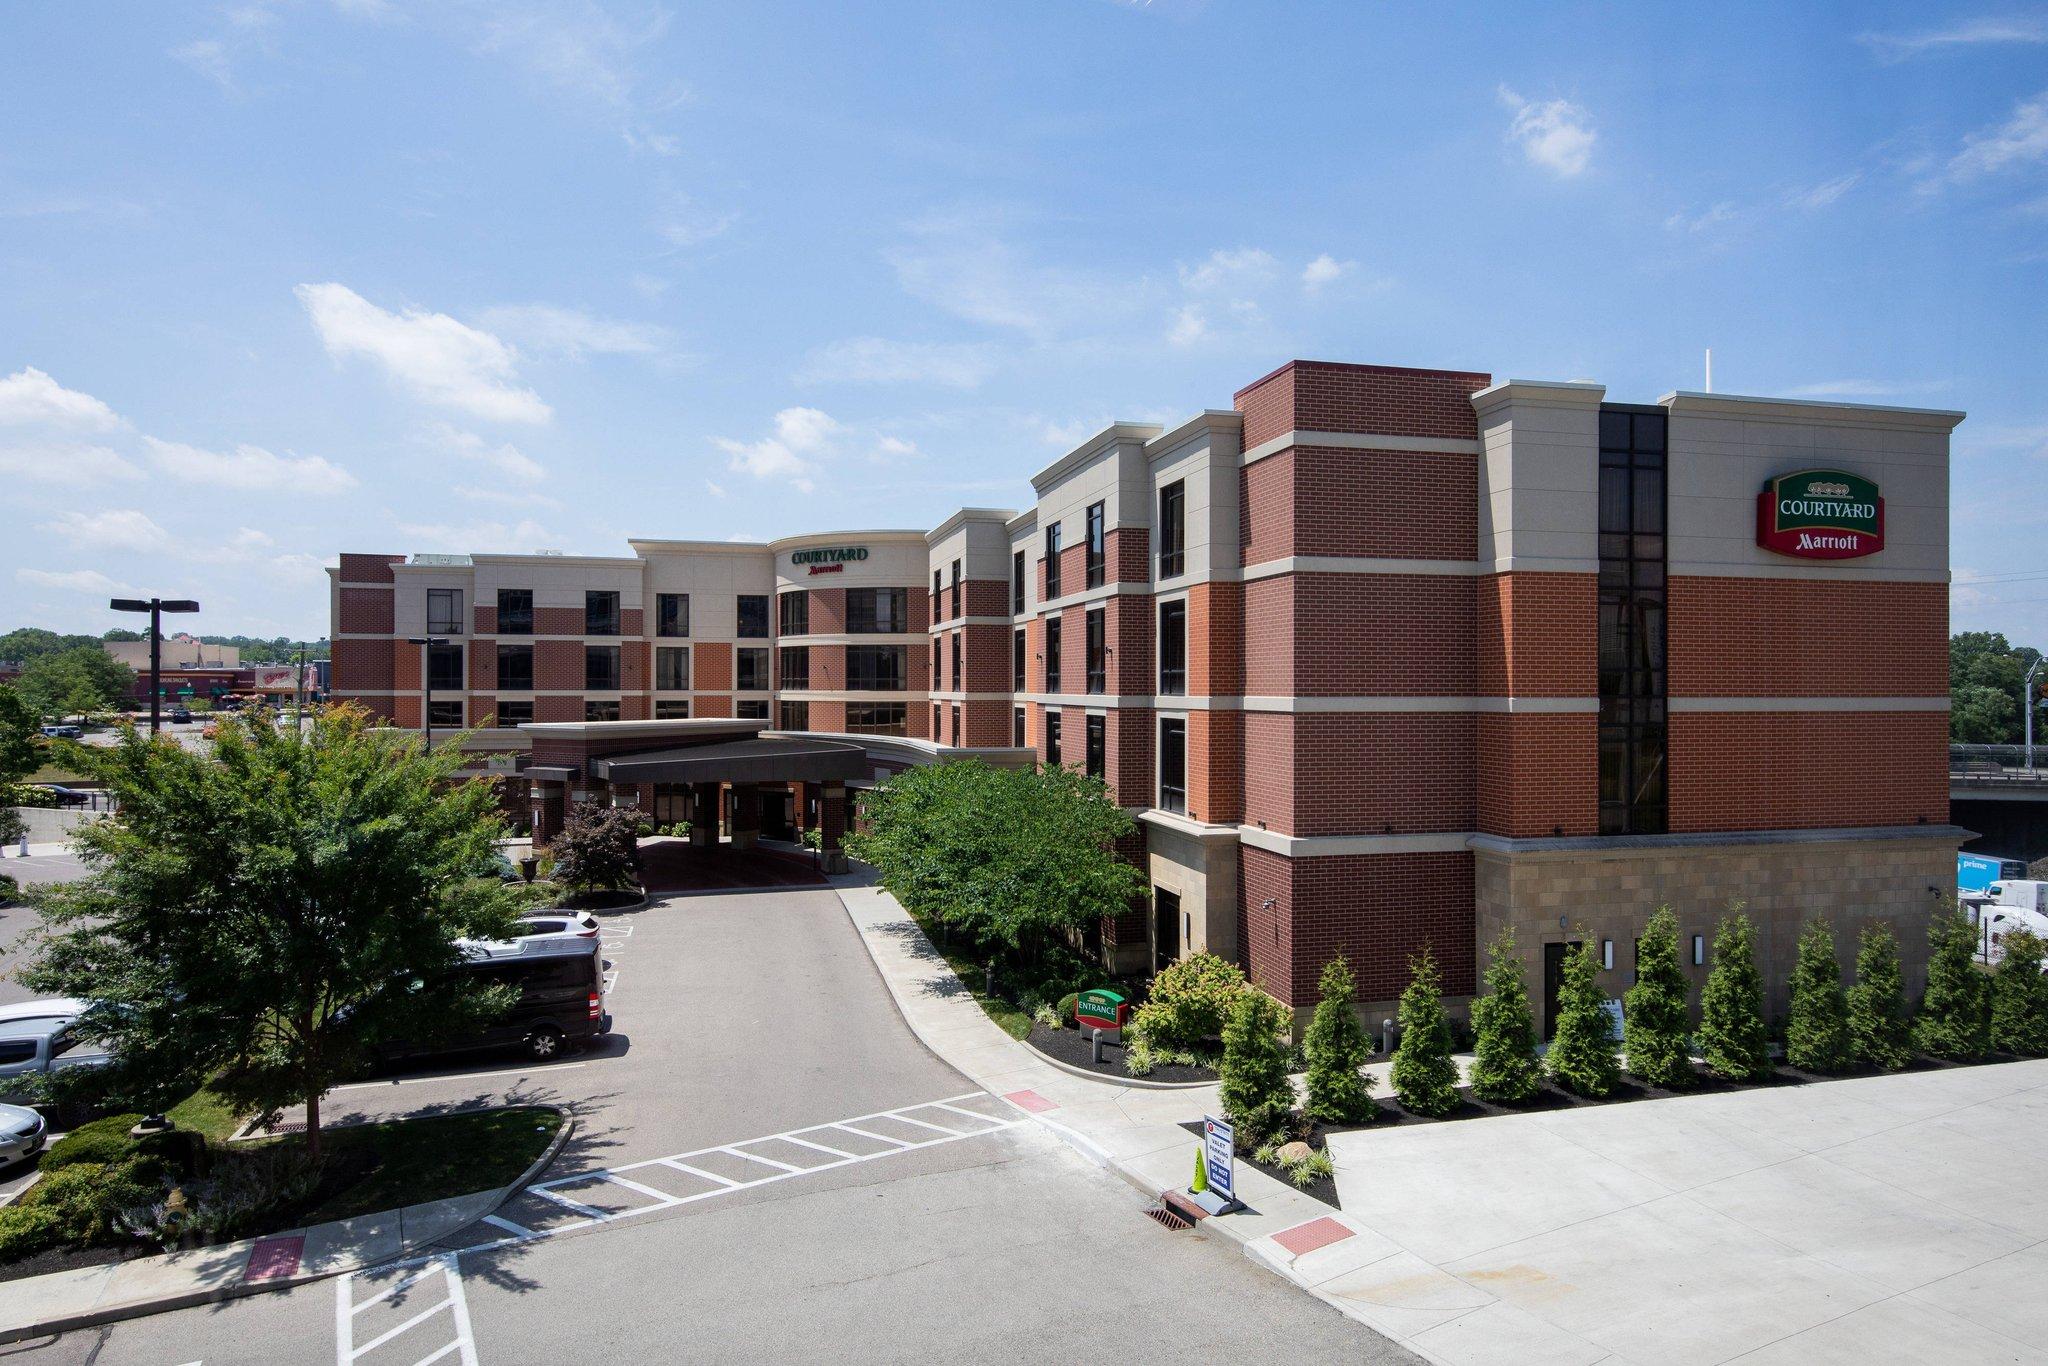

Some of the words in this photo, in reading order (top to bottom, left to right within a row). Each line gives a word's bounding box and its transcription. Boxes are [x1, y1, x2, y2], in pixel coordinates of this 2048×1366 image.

[1780, 500, 1875, 519] COURTYARD
[1796, 533, 1858, 550] Marriott
[792, 548, 868, 564] COURTYARD
[808, 564, 843, 575] Marriott
[1963, 860, 1987, 870] prime
[1079, 1001, 1115, 1016] ENTRANCE
